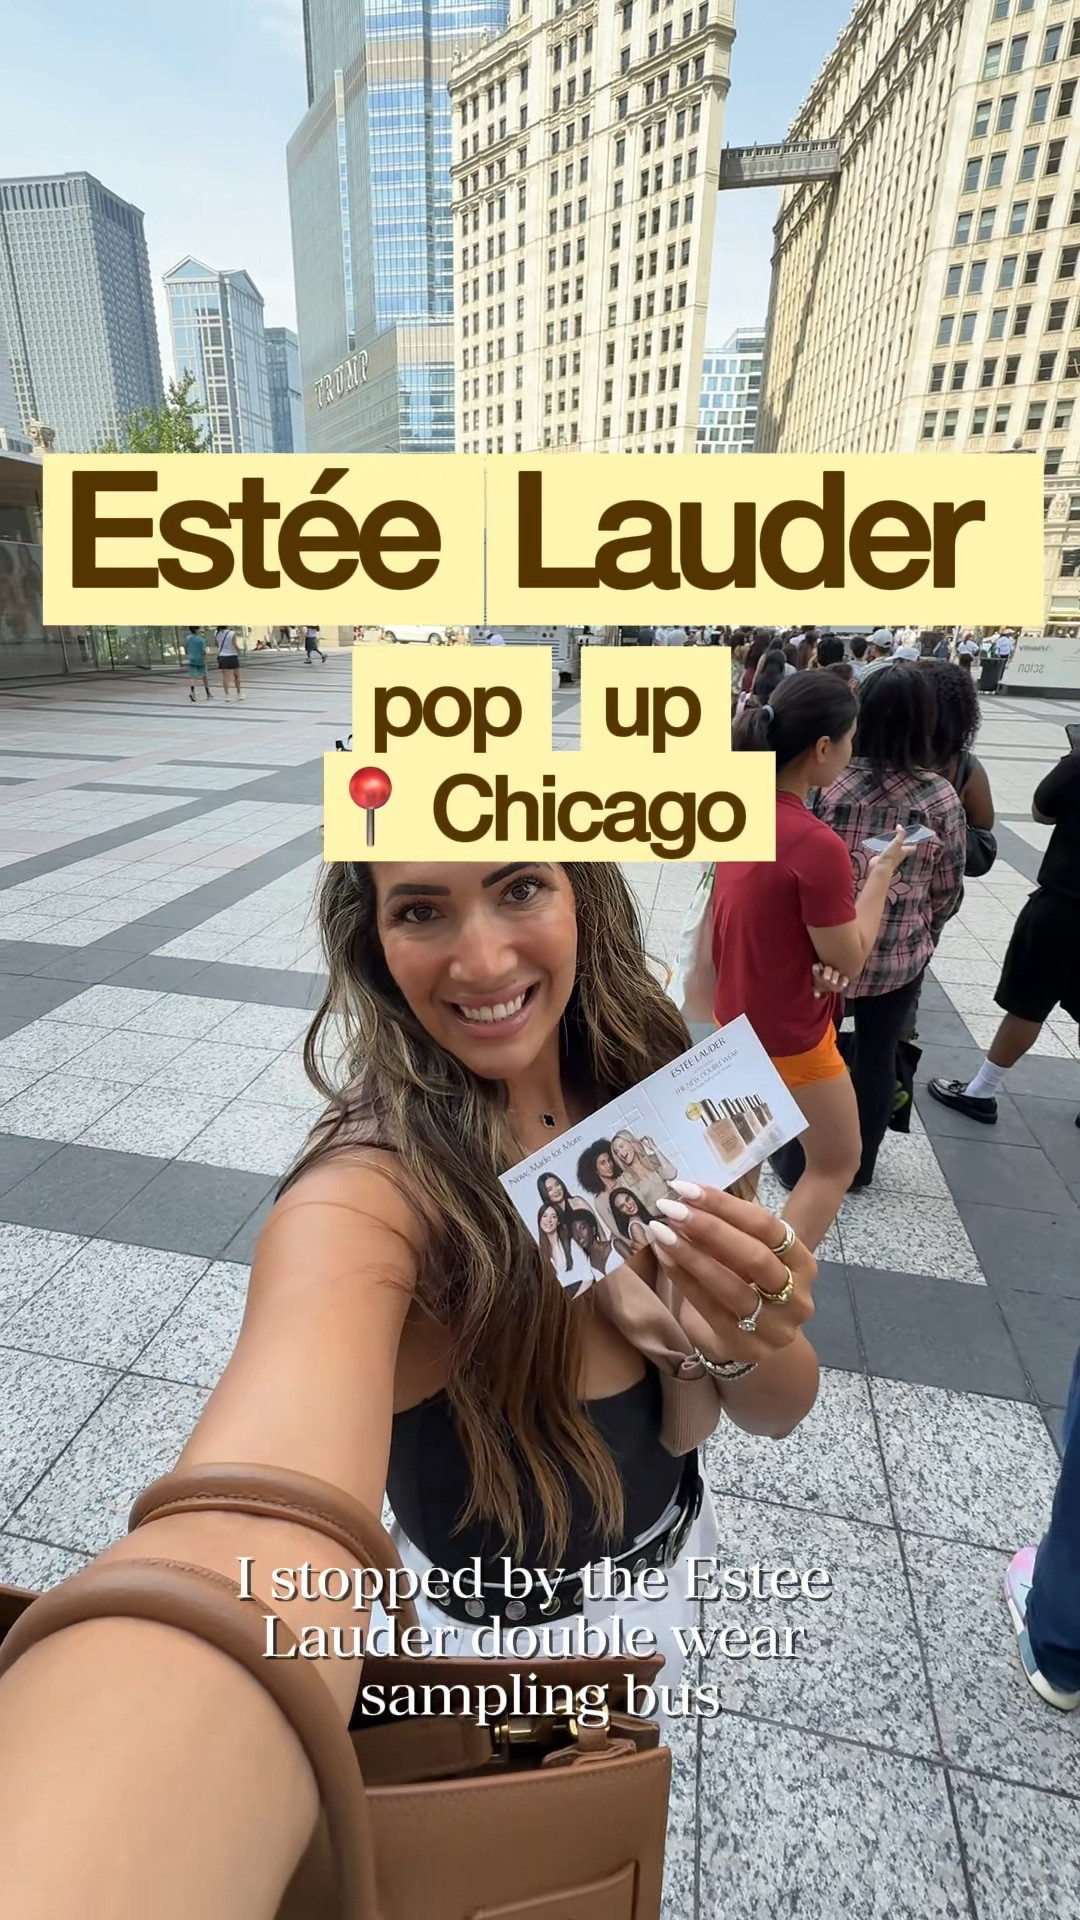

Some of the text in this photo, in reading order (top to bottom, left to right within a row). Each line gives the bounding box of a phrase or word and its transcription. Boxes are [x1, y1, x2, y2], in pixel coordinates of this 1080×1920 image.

[314, 349, 370, 410] TRUMP
[694, 1036, 726, 1062] LAUDER
[529, 1154, 552, 1173] Made
[550, 1148, 563, 1160] for
